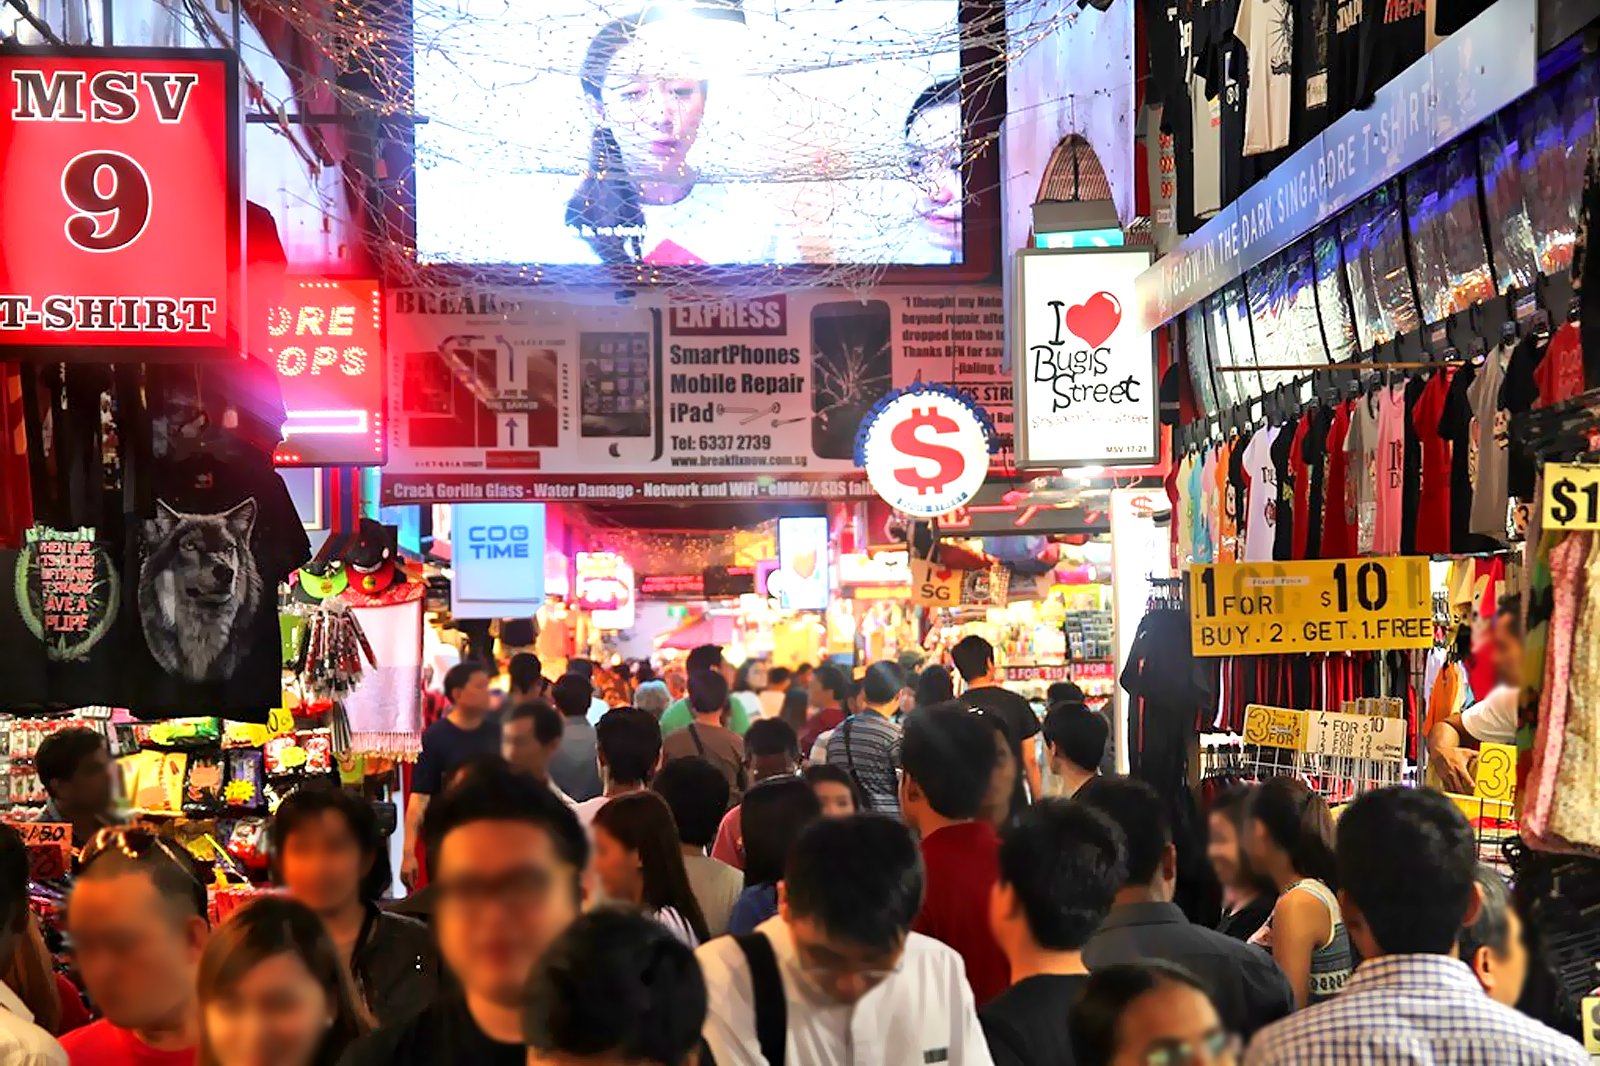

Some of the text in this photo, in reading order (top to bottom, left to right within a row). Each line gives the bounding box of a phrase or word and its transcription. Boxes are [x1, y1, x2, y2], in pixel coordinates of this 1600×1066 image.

[11, 69, 198, 125] MSV
[61, 149, 152, 253] 9
[1171, 249, 1201, 297] GLOW
[1203, 238, 1216, 276] IN
[1218, 221, 1239, 265] THE
[1241, 195, 1274, 248] DARK
[1277, 134, 1356, 224] SINGAPORE
[0, 294, 216, 333] T-SHIRT
[675, 301, 781, 329] EXPRESS
[1046, 300, 1066, 346] I
[670, 343, 800, 365] SmartPhones
[670, 372, 805, 396] Mobile Repair
[670, 401, 714, 423] iPad
[671, 434, 772, 451] Tel: 6337 2739
[890, 406, 966, 496] $
[392, 483, 434, 499] Crack
[436, 483, 484, 499] Gorilla
[485, 483, 525, 499] Glass
[533, 483, 576, 498] Water
[577, 482, 635, 500] Damage
[643, 482, 701, 498] Network
[701, 482, 728, 497] and
[728, 480, 759, 497] WiFi
[469, 543, 529, 560] TIME
[925, 566, 933, 583] I
[921, 583, 950, 602] SG
[1201, 561, 1388, 617] 1 FOR $10
[1376, 617, 1432, 639] FREE
[1246, 707, 1271, 743] 3
[1268, 732, 1295, 746] FOR
[1332, 719, 1359, 735] FOR
[1363, 716, 1385, 733] $10
[1477, 748, 1511, 798] 3
